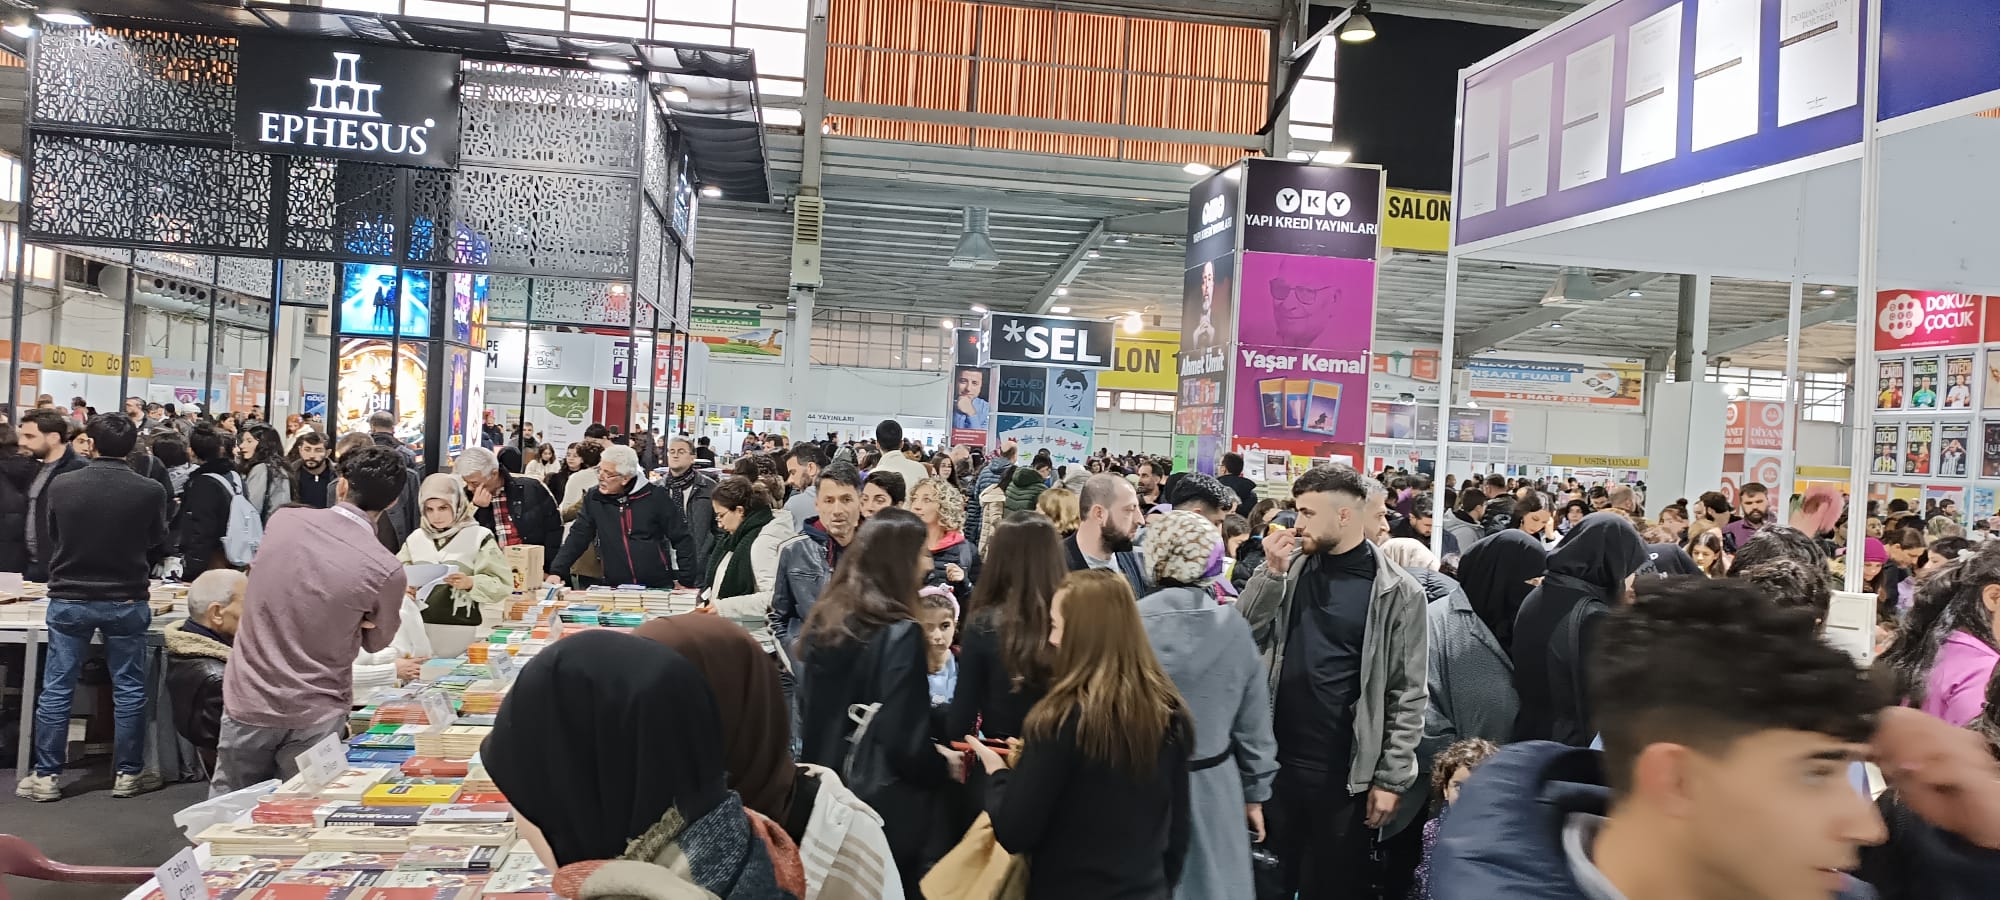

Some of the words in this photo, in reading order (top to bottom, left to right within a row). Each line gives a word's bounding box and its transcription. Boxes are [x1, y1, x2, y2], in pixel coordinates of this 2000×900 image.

[259, 112, 428, 155] EPHESUS
[1388, 196, 1449, 222] SALON
[1245, 214, 1273, 227] YAPI
[1275, 215, 1313, 230] KREDİ
[1316, 220, 1378, 235] YAYINLARI
[1926, 293, 1975, 312] DOKUZ
[1924, 311, 1974, 334] ÇOCUK
[1180, 355, 1205, 377] Ahmet
[1205, 347, 1225, 373] Ümit
[1242, 350, 1298, 373] Yaşar
[1302, 352, 1367, 375] Kemal
[1001, 377, 1044, 390] MEHMED
[1521, 373, 1565, 382] FUARI
[1000, 390, 1045, 407] UZUN
[167, 860, 190, 880] Tekin
